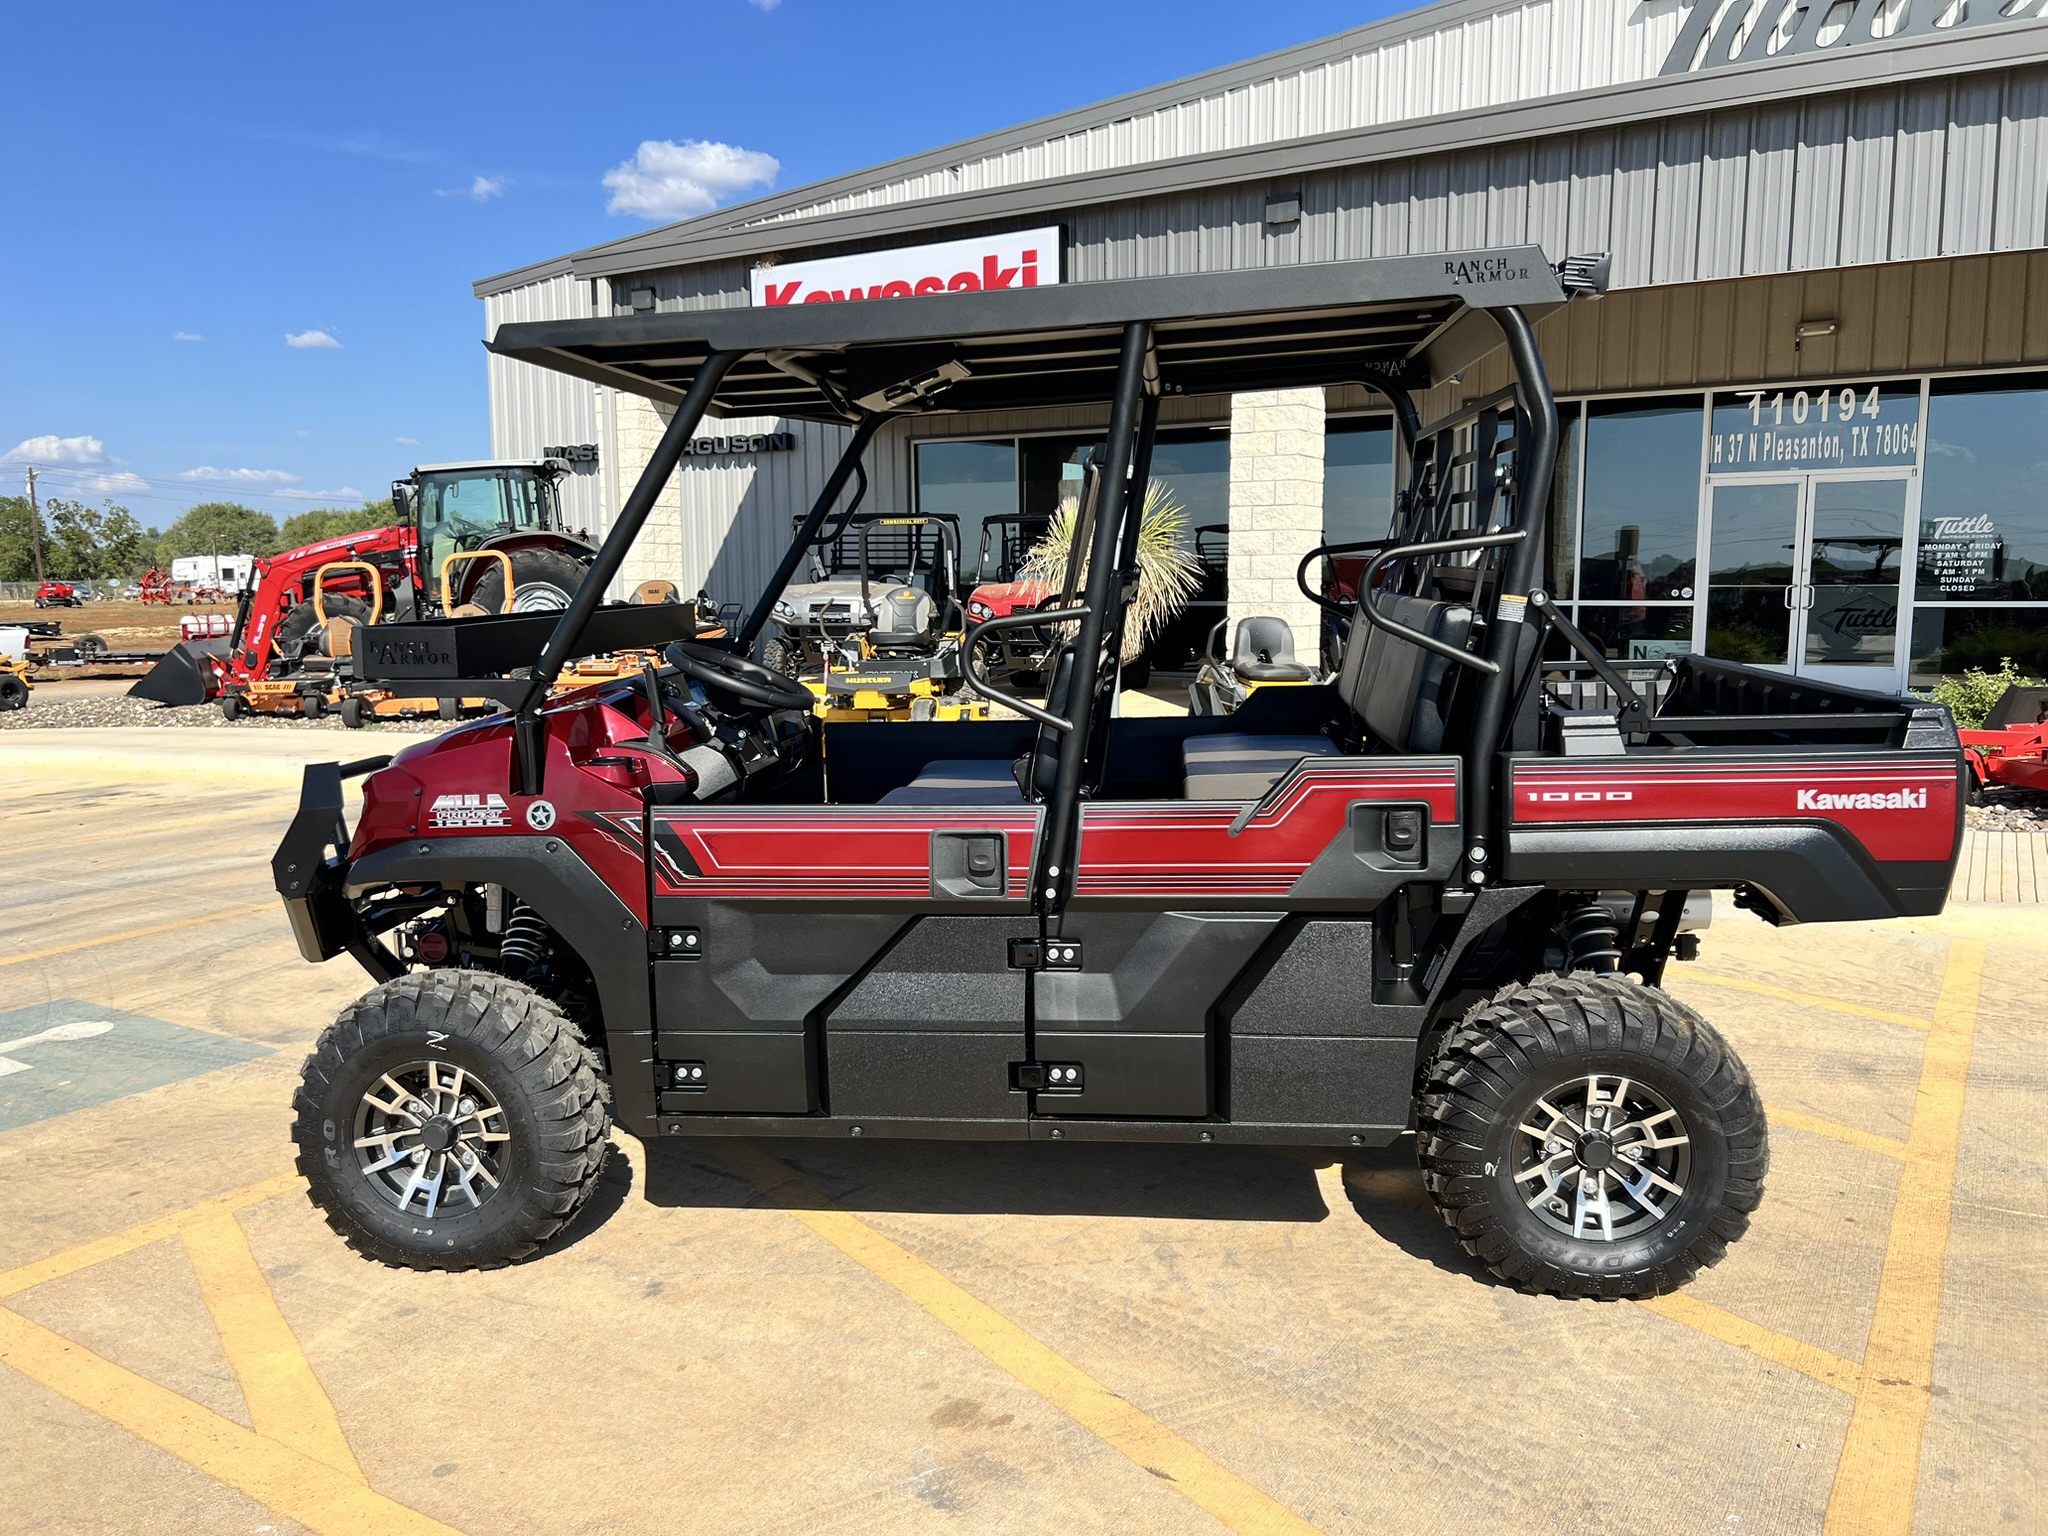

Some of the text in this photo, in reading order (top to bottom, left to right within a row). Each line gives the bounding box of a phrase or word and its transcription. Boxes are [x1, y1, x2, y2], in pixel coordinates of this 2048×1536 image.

[1445, 258, 1507, 282] RANCH
[1453, 262, 1529, 285] ARMOR
[1748, 386, 1880, 427] 110194
[1728, 433, 1743, 464] 37
[1749, 432, 1758, 462] N
[1763, 429, 1845, 465] Pleasanton,
[1852, 425, 1869, 457] TX
[1876, 422, 1917, 456] 78064
[1933, 513, 1994, 540] Tuttle
[1924, 543, 1962, 551] MONDAY
[1969, 542, 2002, 550] FRIDAY
[1833, 605, 1897, 634] Tuttl
[1527, 791, 1633, 802] 1000
[1796, 788, 1927, 810] Kawasaki
